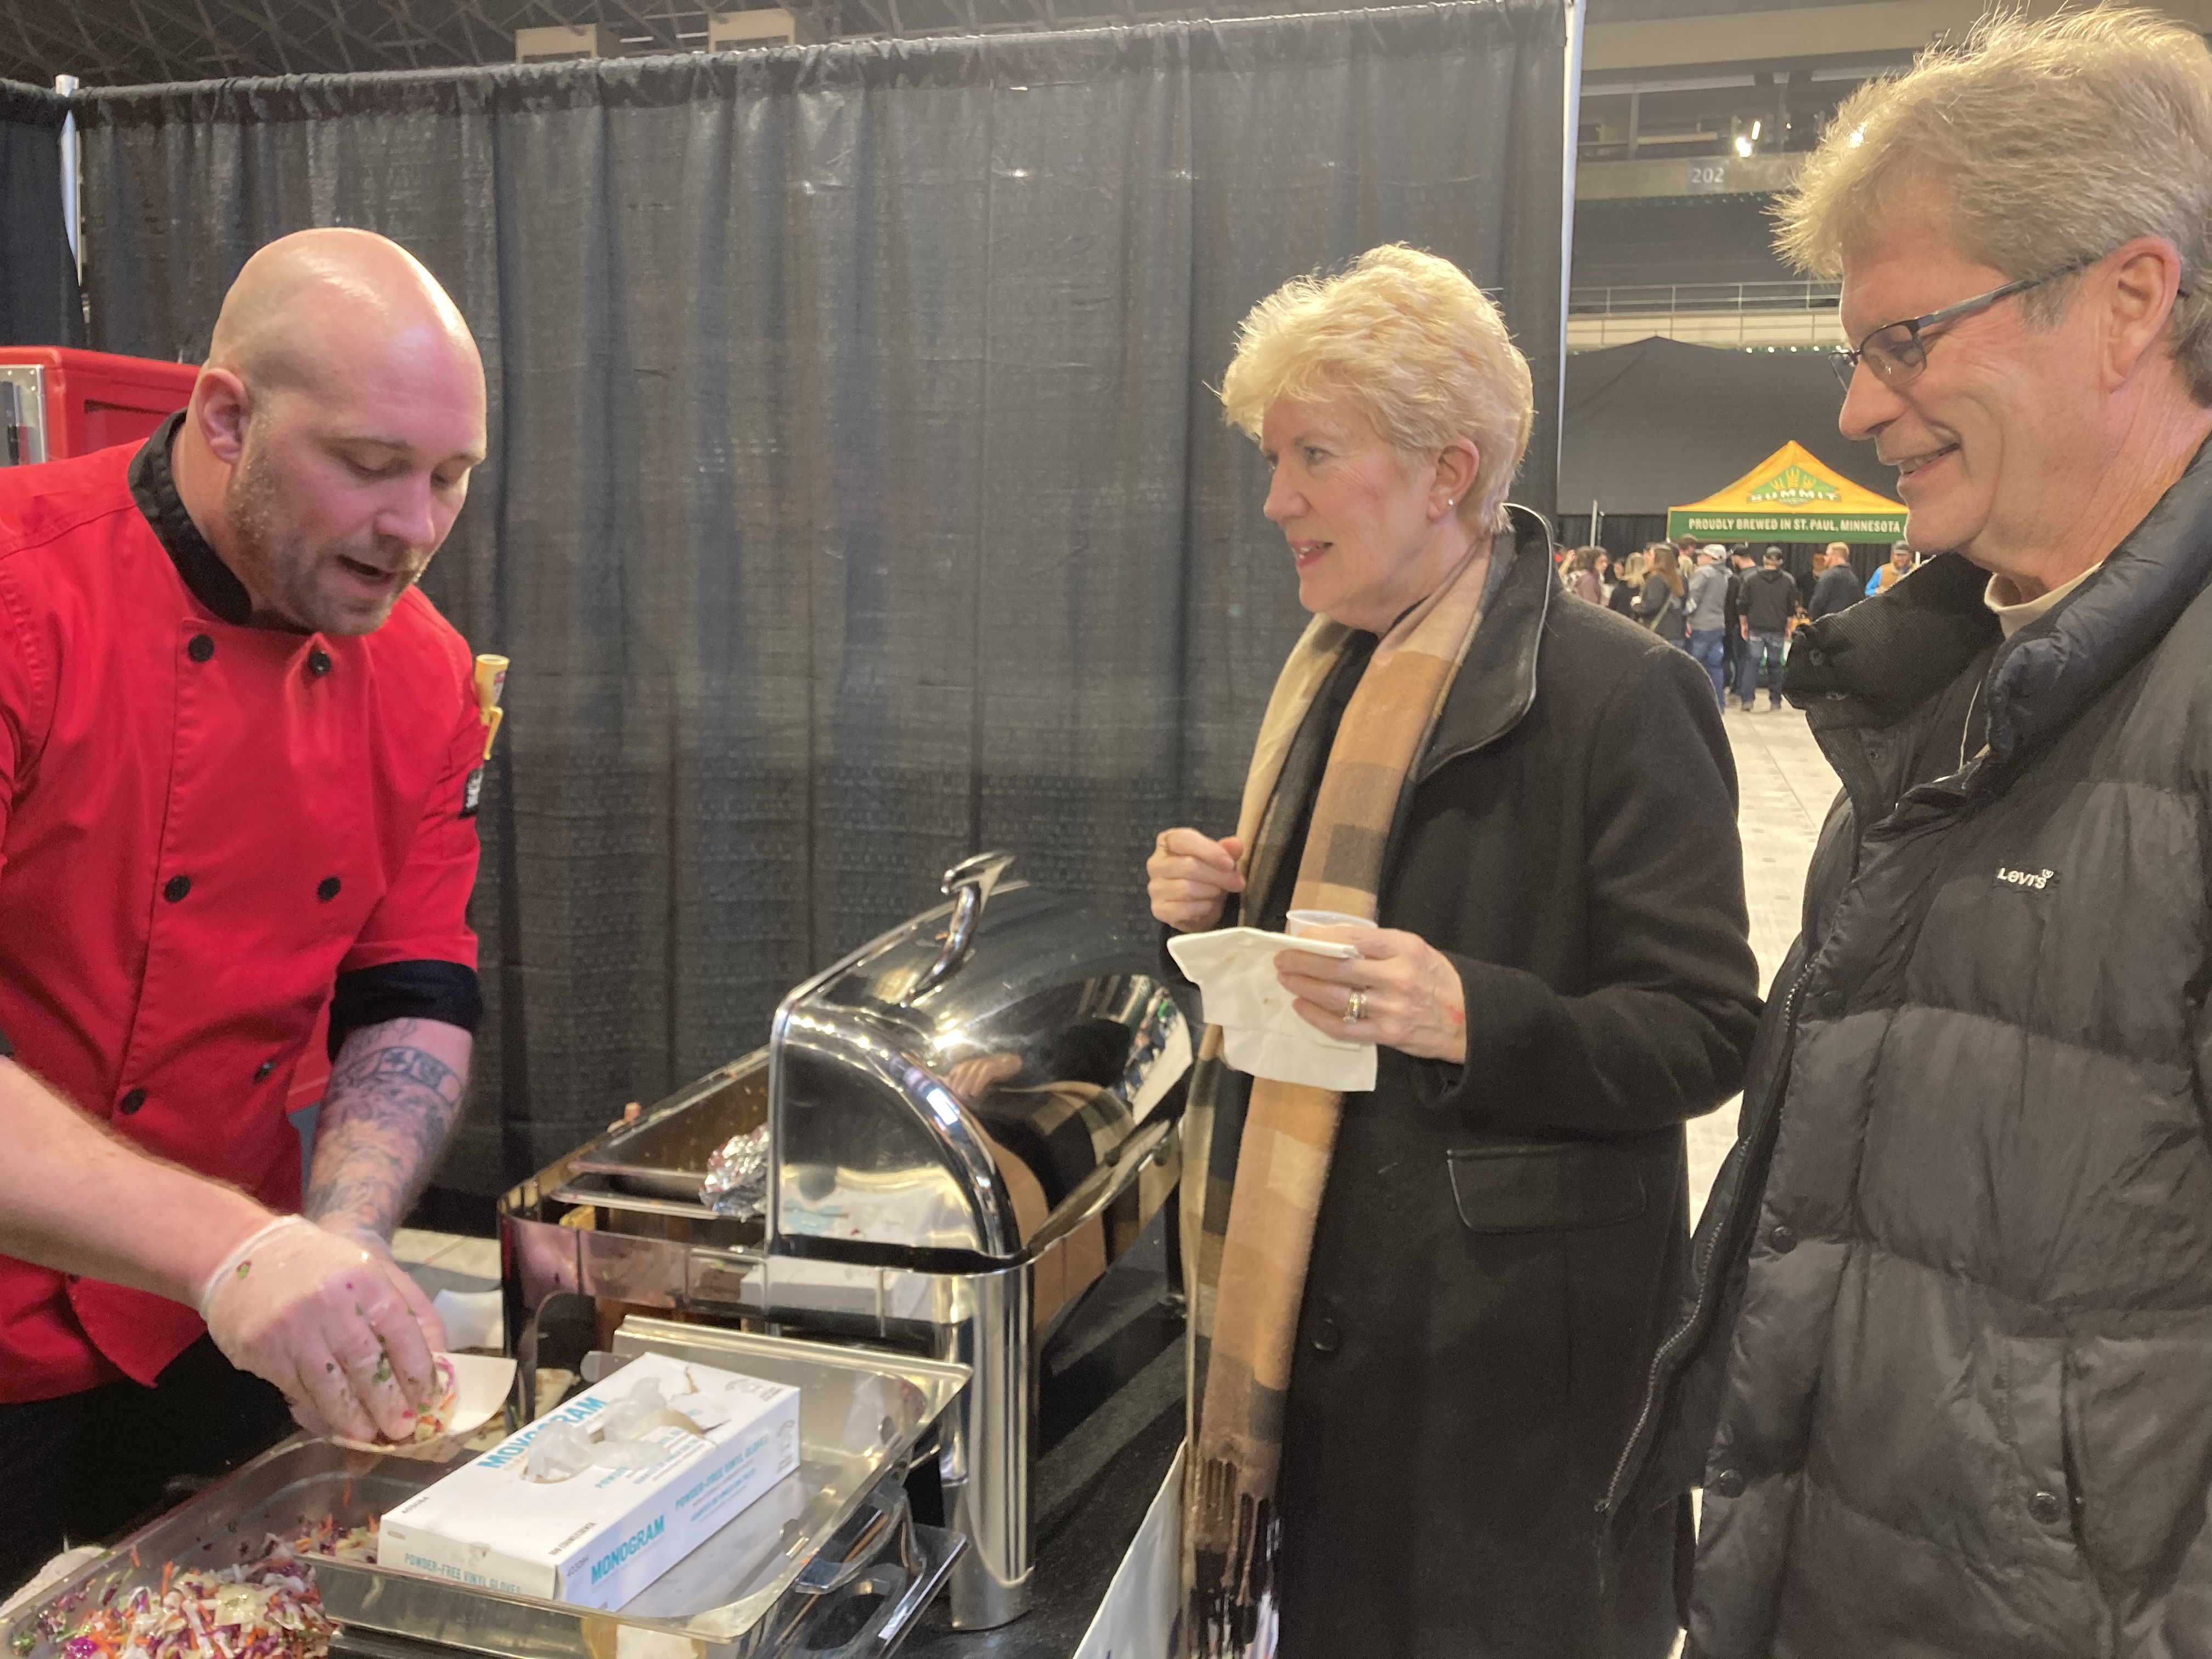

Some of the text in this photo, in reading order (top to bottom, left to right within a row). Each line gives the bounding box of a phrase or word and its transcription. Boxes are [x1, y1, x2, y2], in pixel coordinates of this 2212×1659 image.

[1691, 167, 1724, 183] 202
[1751, 489, 1837, 501] SUMMIT
[1689, 518, 1900, 533] PROUDLY BREWED IN ST. PAUL, MINNESOTA
[591, 1514, 665, 1584] MONOGRAM
[404, 1553, 461, 1580] POWDER-FREE
[464, 1571, 486, 1587] VINYL
